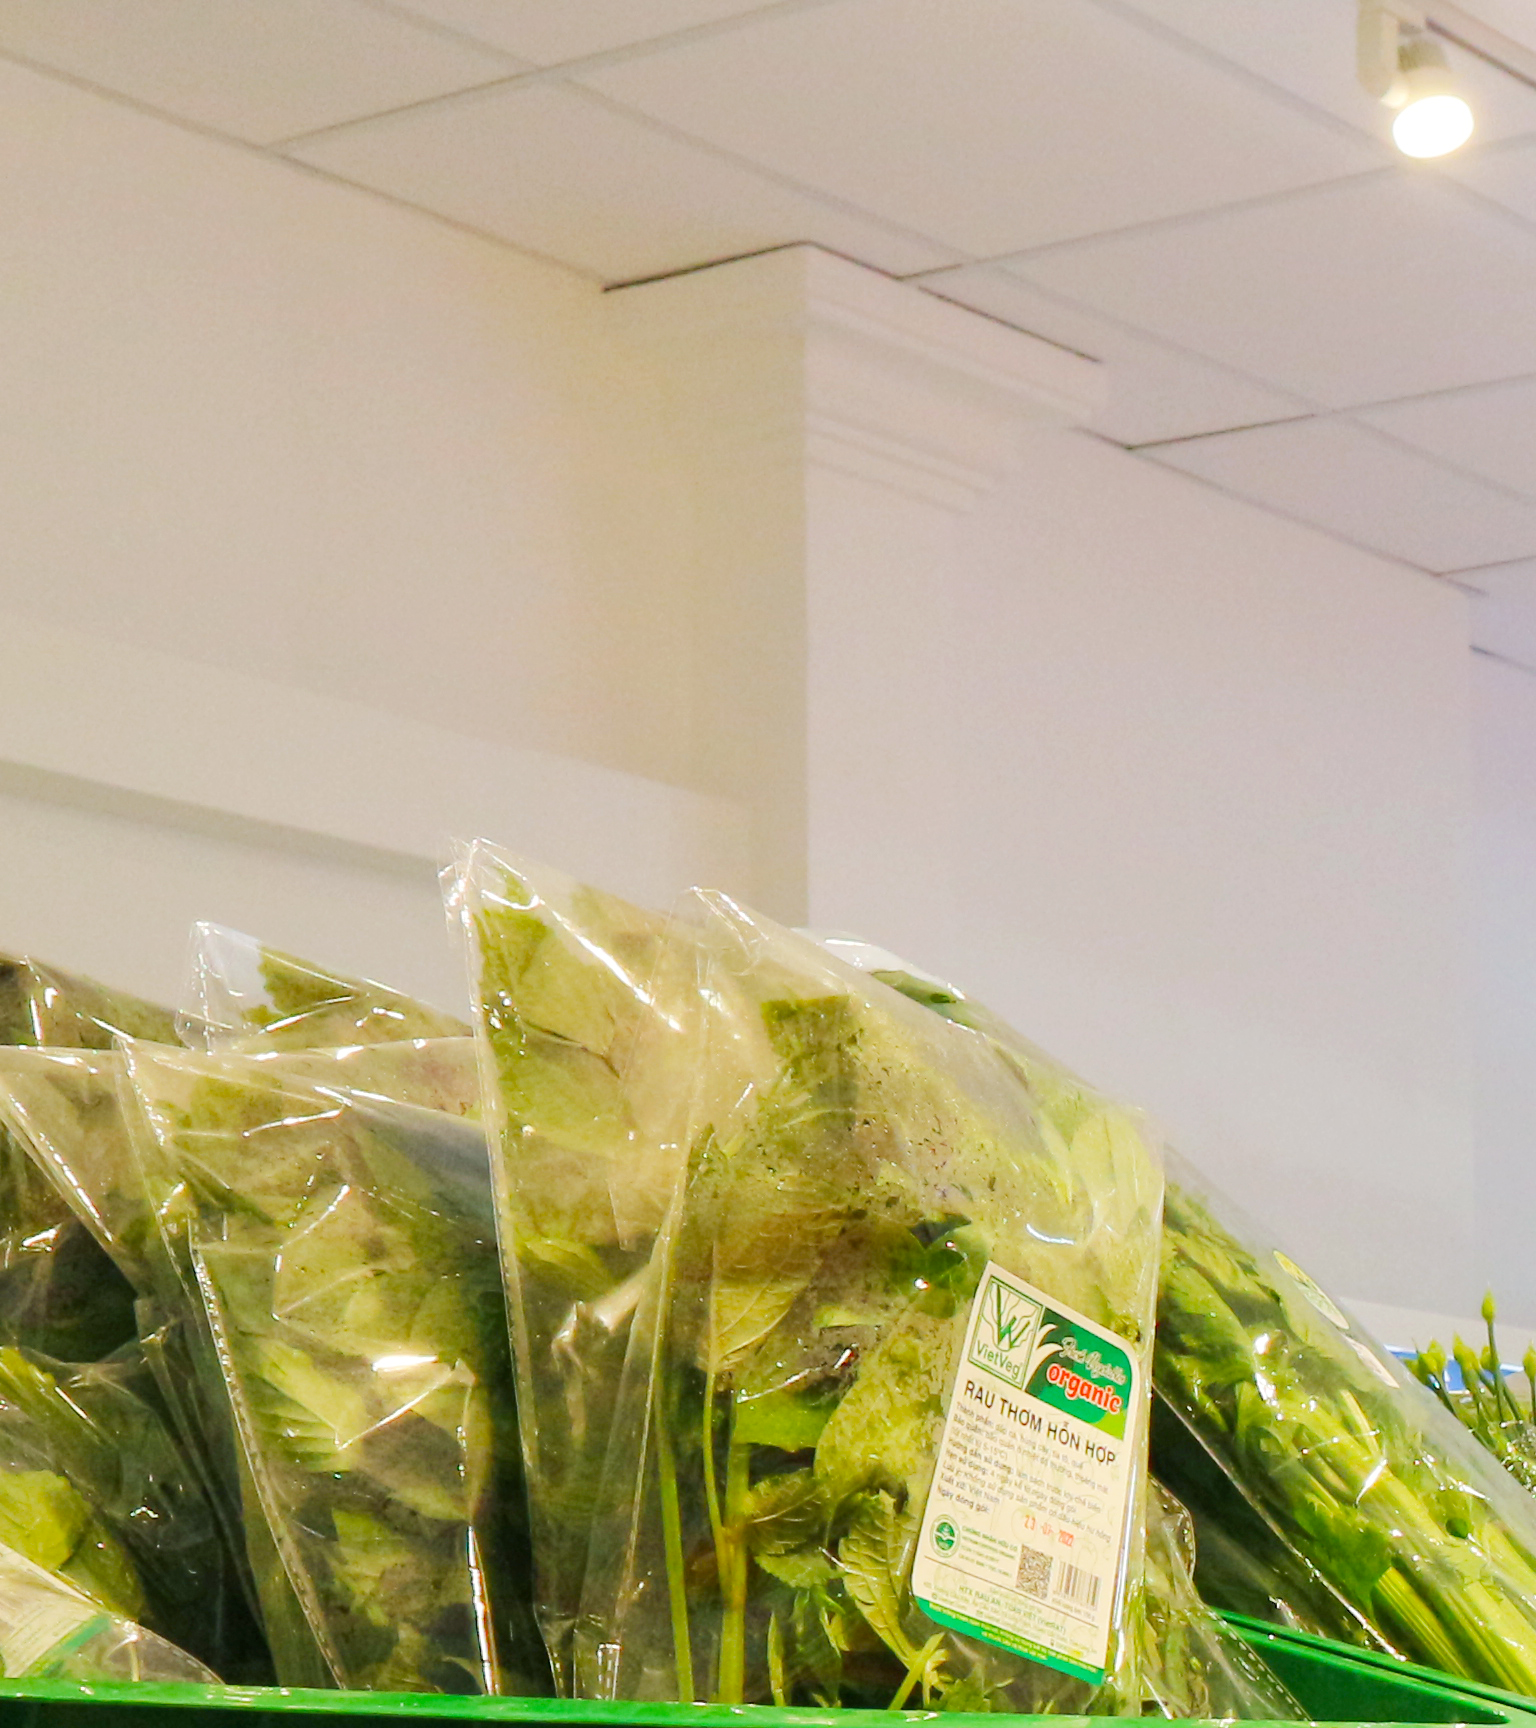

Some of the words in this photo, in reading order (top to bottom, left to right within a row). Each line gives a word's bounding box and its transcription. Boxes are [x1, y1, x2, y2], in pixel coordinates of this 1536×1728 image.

[976, 1340, 1023, 1380] VietVeg
[1047, 1363, 1123, 1414] organic
[964, 1380, 996, 1409] RAU
[1000, 1398, 1042, 1433] THƠM
[1047, 1421, 1081, 1451] HỖN
[1085, 1440, 1116, 1467] HỢP
